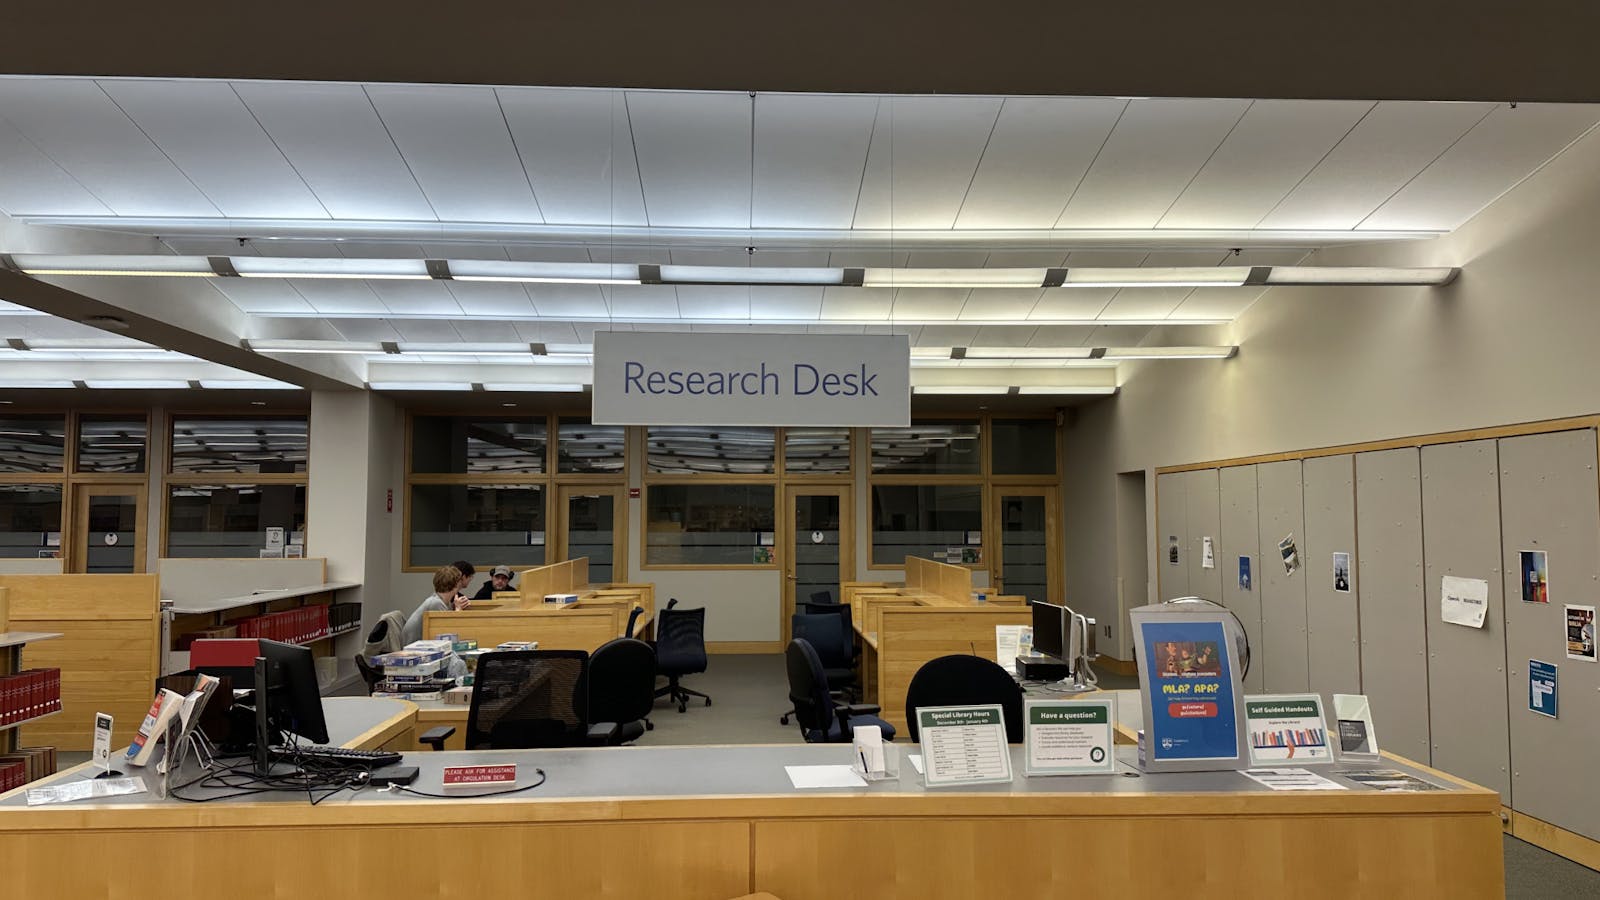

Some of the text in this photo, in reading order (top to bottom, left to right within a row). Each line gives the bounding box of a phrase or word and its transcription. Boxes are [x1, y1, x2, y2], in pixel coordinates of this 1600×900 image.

[624, 361, 879, 397] Research Desk
[1162, 683, 1220, 694] MLA? APA?
[1285, 705, 1314, 713] Handouts
[931, 712, 952, 720] Special
[1064, 712, 1097, 720] question?
